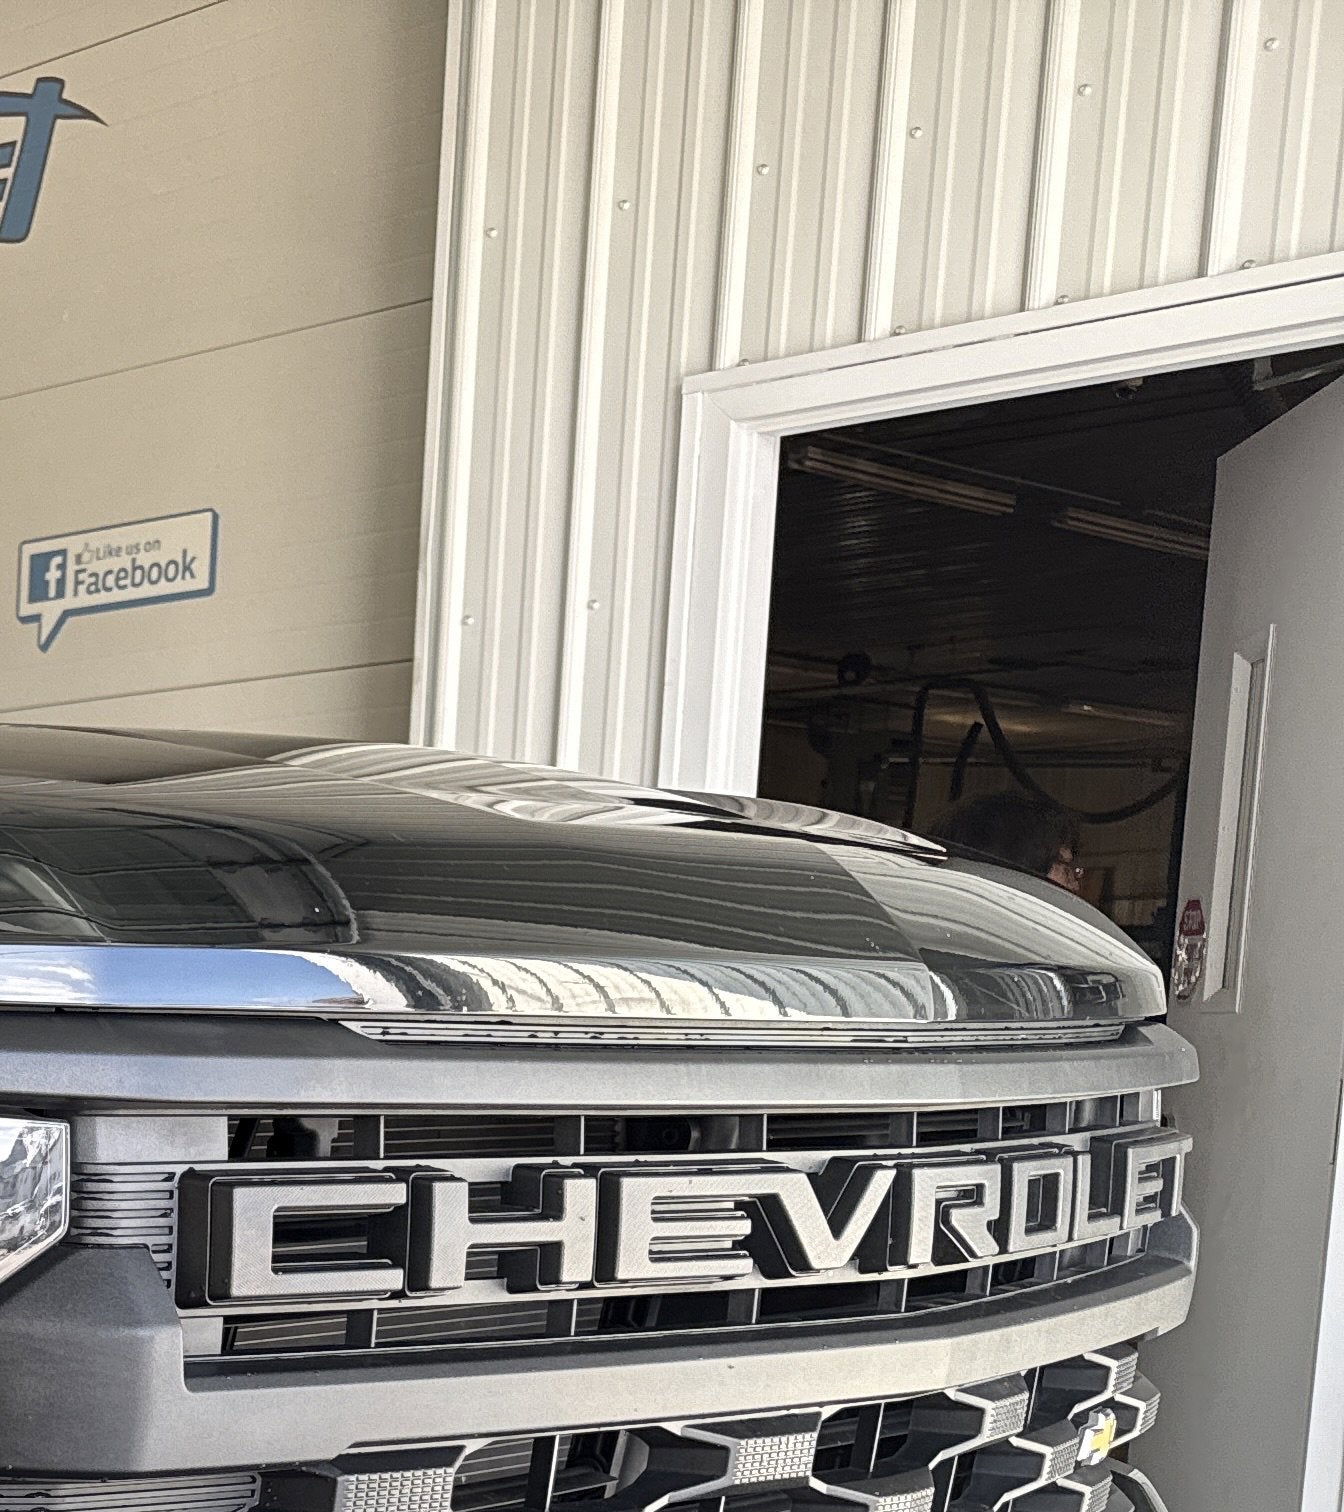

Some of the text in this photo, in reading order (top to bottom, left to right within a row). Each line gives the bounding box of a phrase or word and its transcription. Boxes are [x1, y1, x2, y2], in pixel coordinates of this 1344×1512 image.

[73, 549, 198, 597] Facebook
[95, 539, 162, 561] Like us on
[222, 1133, 1193, 1298] CHEVROLET
